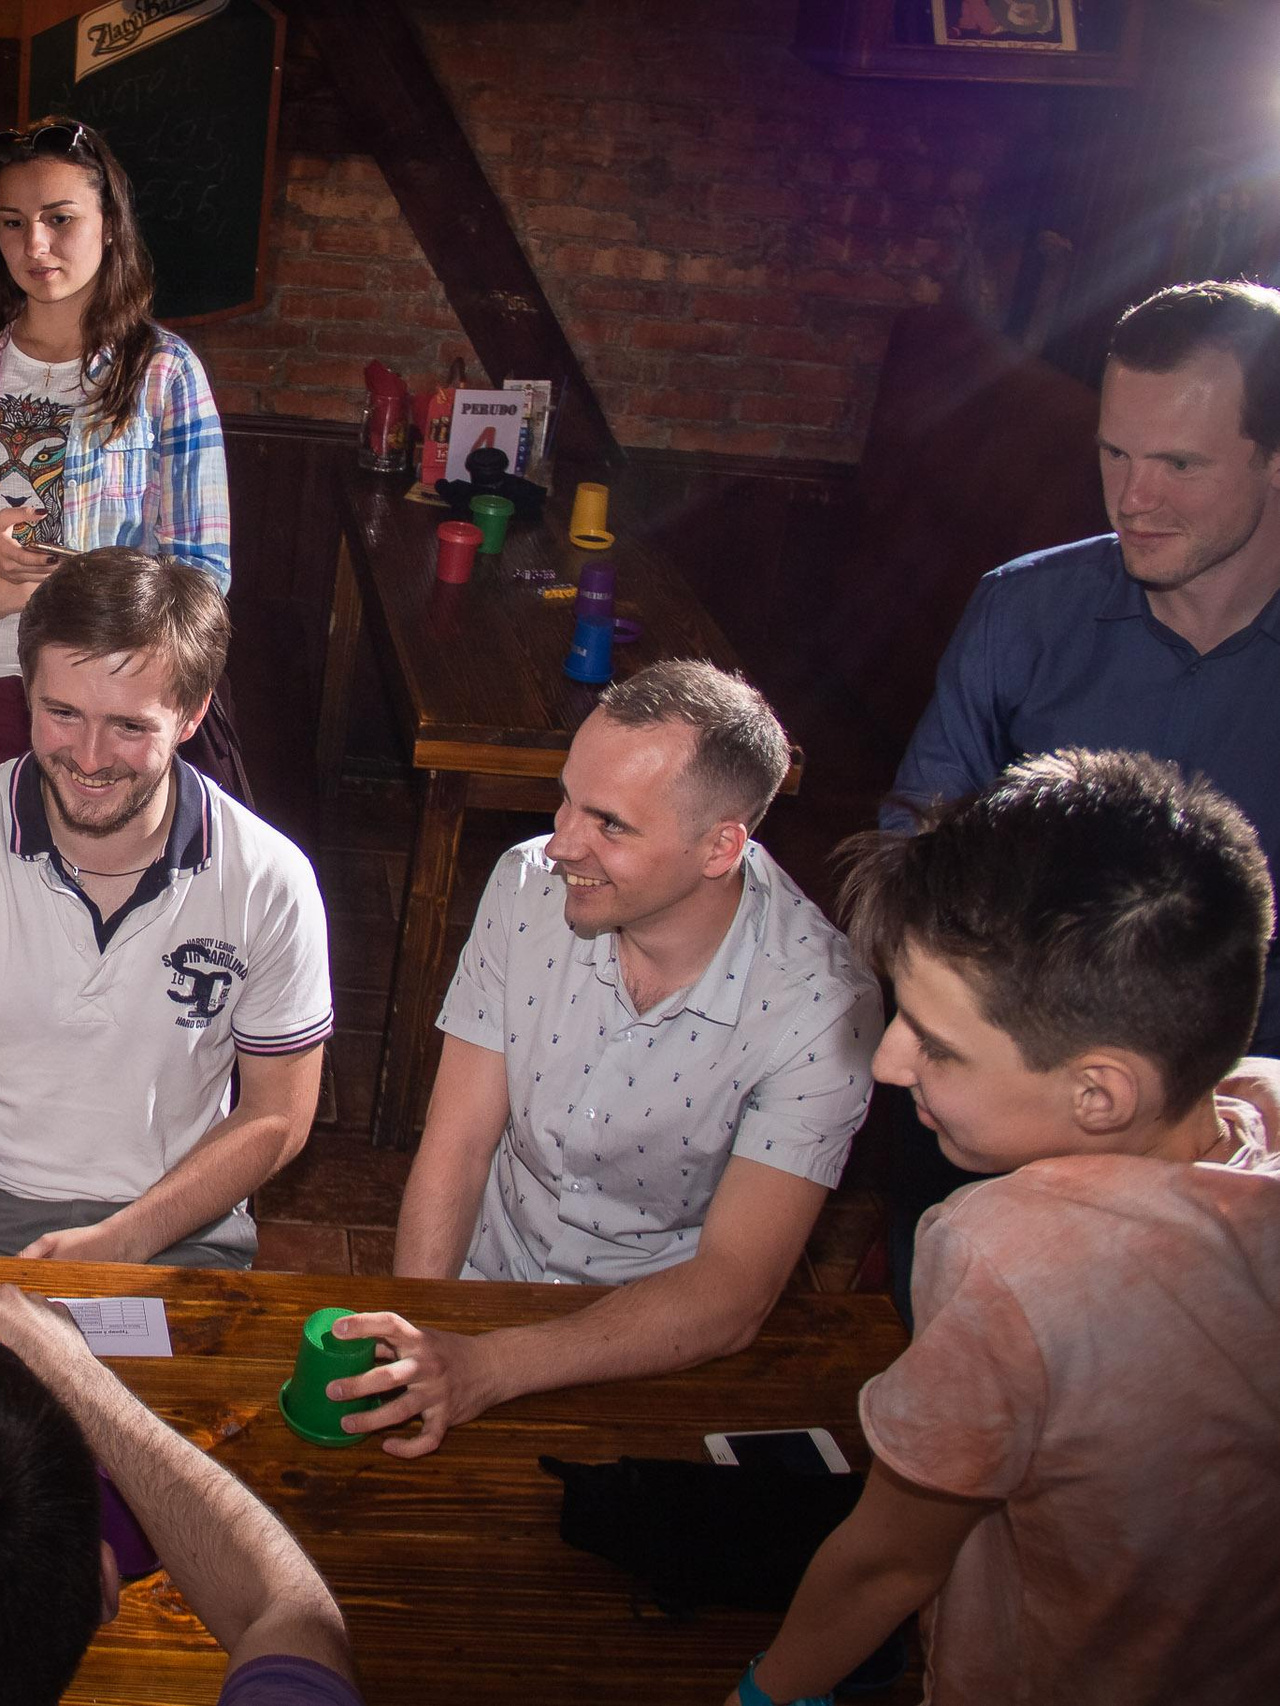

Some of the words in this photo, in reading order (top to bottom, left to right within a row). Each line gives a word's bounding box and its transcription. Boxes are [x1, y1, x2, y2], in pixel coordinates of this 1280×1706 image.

[460, 403, 518, 416] PERUDO
[171, 972, 186, 986] 18
[175, 1016, 195, 1029] HARD
